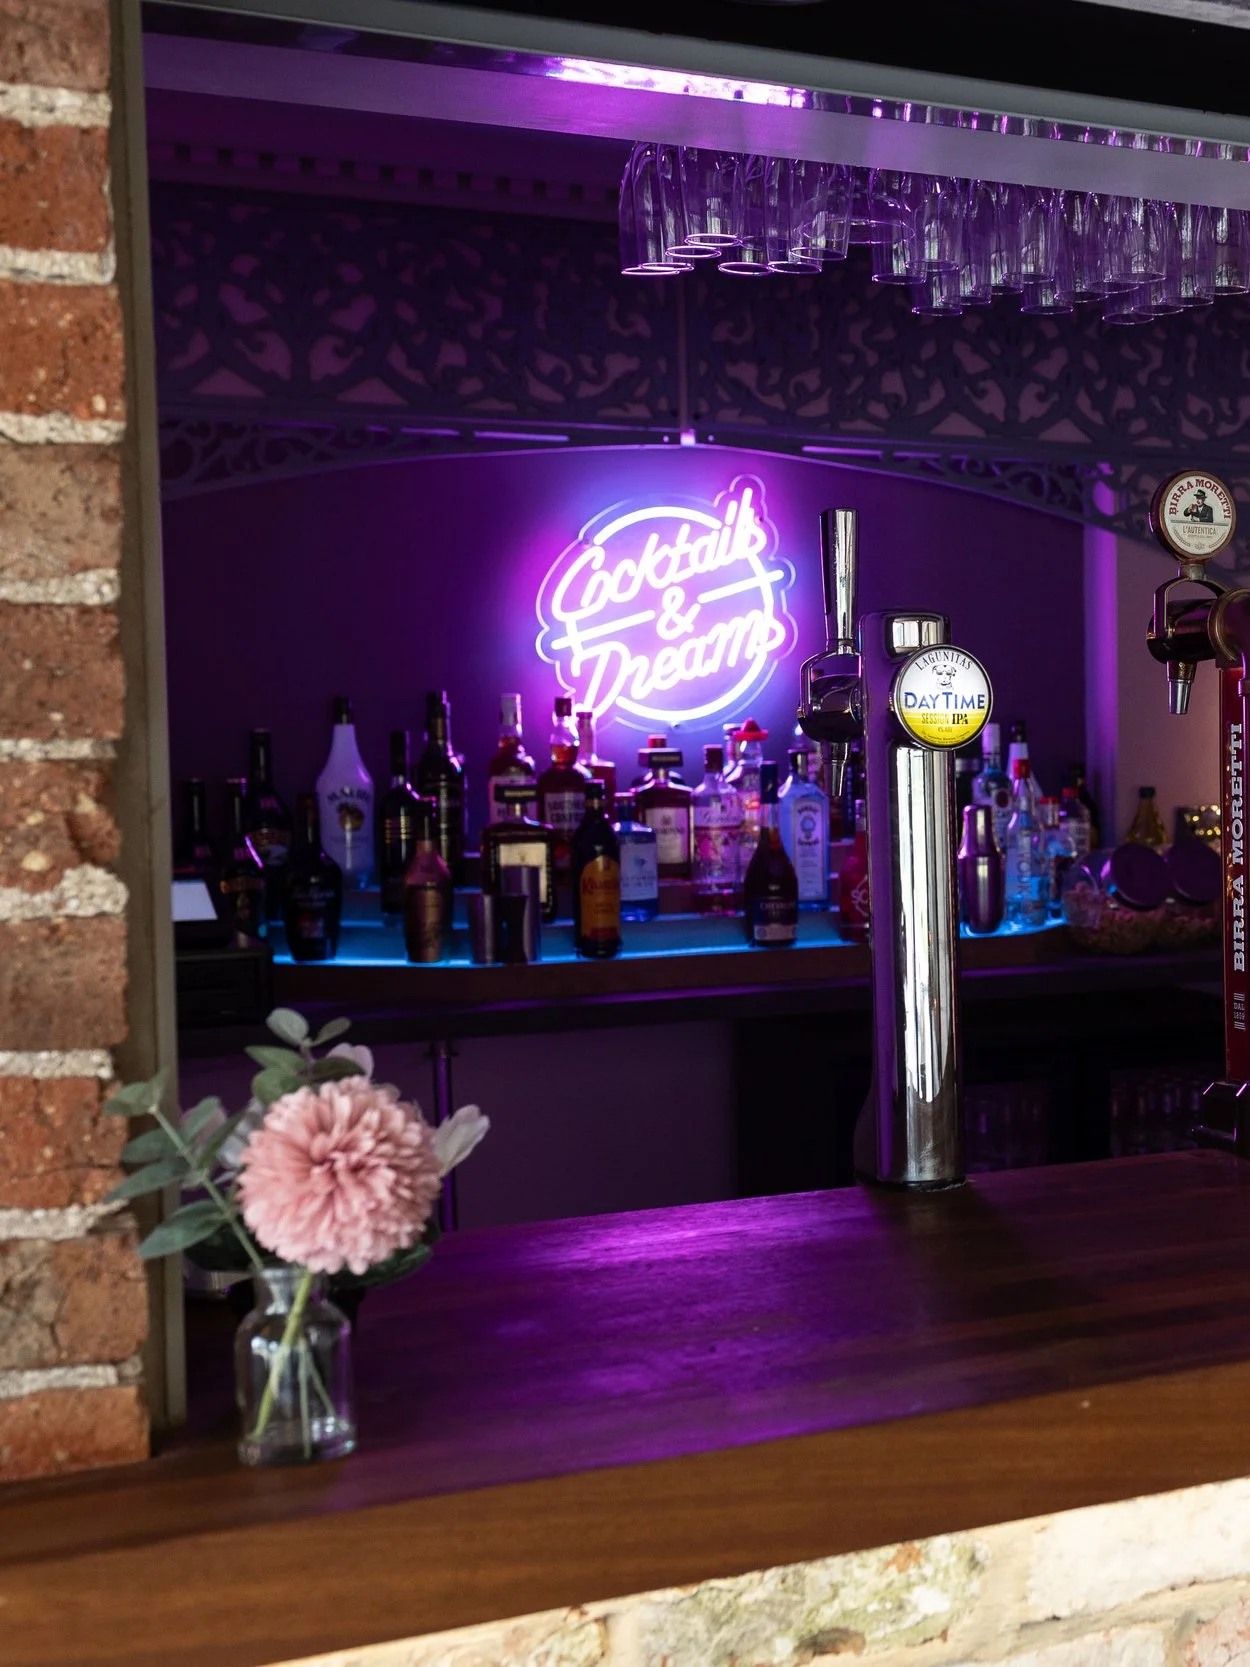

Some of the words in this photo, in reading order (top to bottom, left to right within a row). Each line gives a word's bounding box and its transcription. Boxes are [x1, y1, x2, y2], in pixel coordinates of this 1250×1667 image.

[1169, 480, 1194, 516] BIRRA
[1195, 479, 1231, 519] MORETTI
[1182, 525, 1216, 535] L'AUTENTICA
[551, 487, 767, 622] Cocktails
[656, 585, 701, 640] &
[572, 609, 786, 718] Dreams
[915, 651, 973, 671] LAGUNITAS
[921, 713, 949, 725] SESSION
[951, 713, 969, 725] IPA
[1230, 723, 1244, 865] MORETTI
[1232, 875, 1245, 972] BIRRA
[1233, 1002, 1245, 1011] DAL
